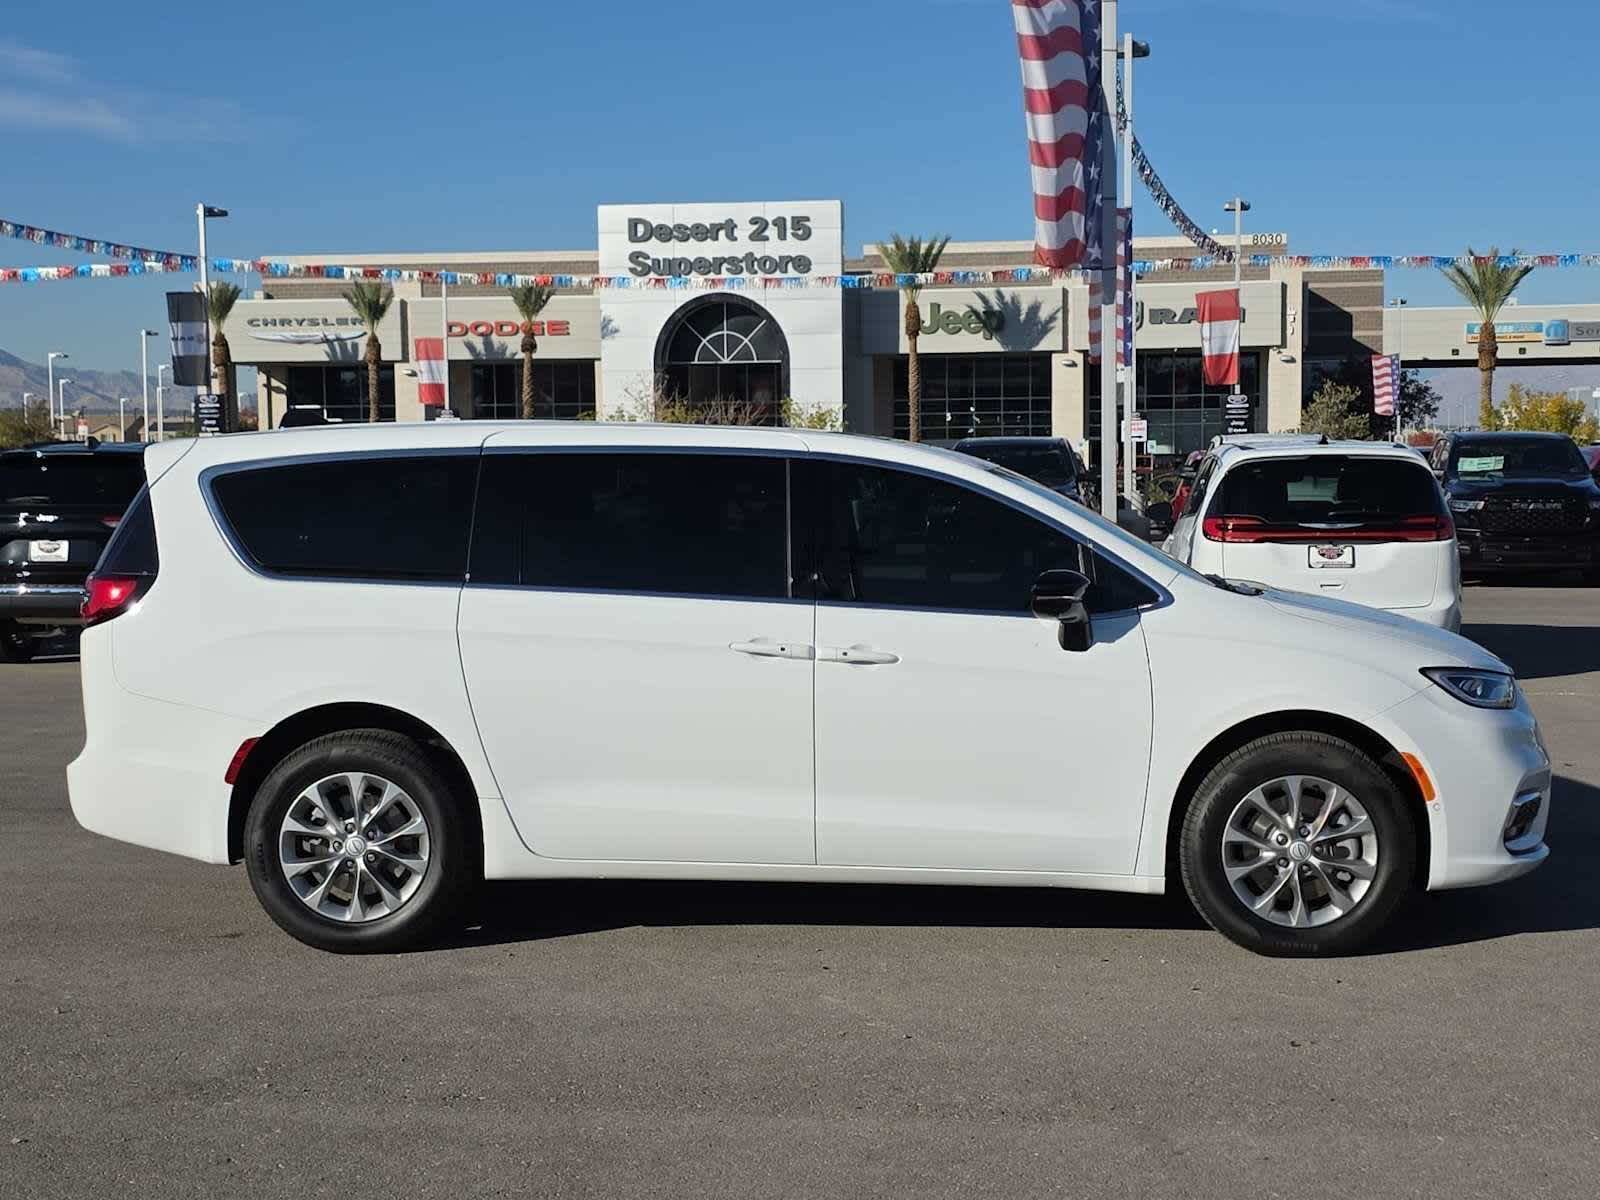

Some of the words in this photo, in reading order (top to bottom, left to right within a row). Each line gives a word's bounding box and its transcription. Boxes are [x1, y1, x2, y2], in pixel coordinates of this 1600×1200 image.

[627, 217, 738, 243] Desert
[748, 215, 812, 242] 215
[1252, 233, 1283, 246] 8030
[627, 250, 812, 278] Superstore
[246, 317, 364, 328] CHRYSLER
[446, 319, 571, 337] DODGE
[919, 301, 1005, 341] Jeep
